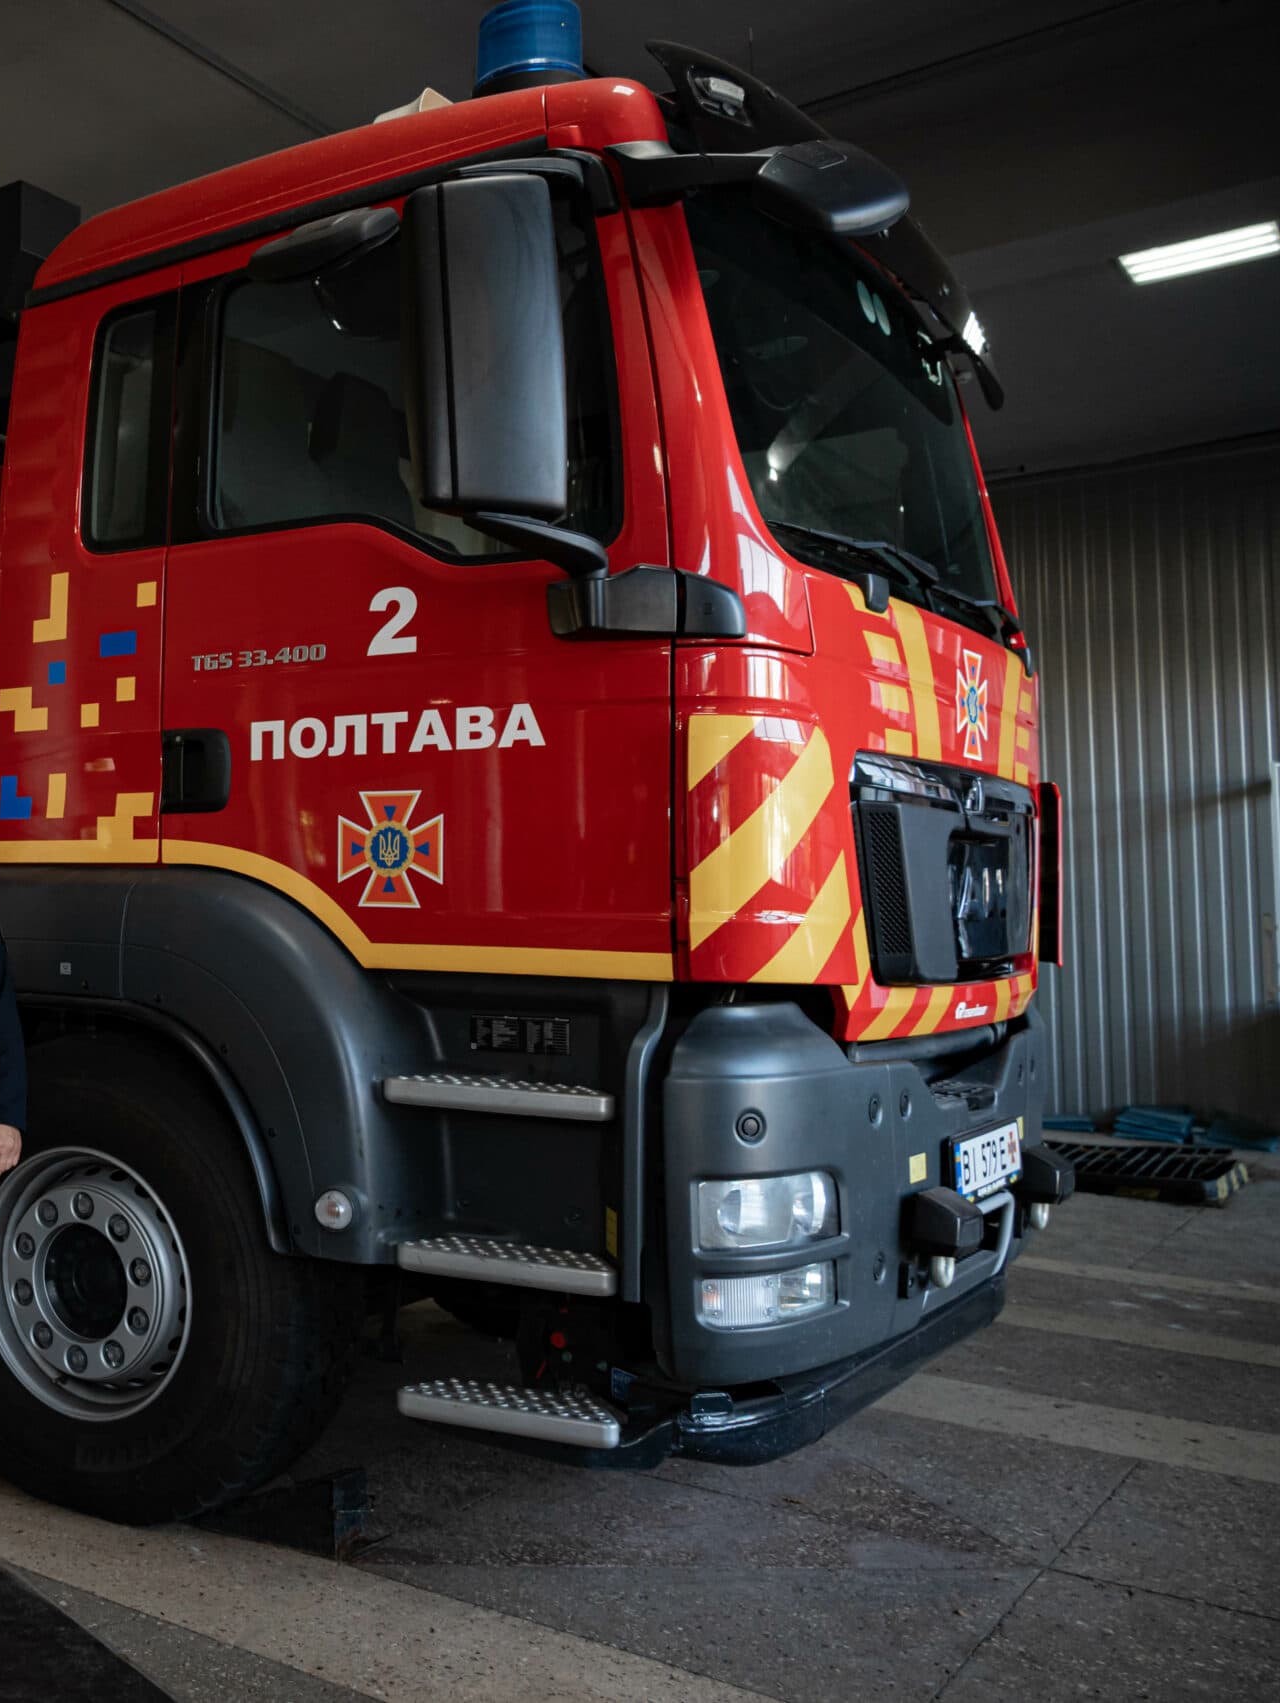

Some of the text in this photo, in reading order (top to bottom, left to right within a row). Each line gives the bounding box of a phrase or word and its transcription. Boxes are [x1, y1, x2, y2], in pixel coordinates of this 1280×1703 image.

[367, 587, 418, 657] 2
[192, 643, 327, 672] TGS 33.400
[250, 703, 546, 761] ПОЛТАВА
